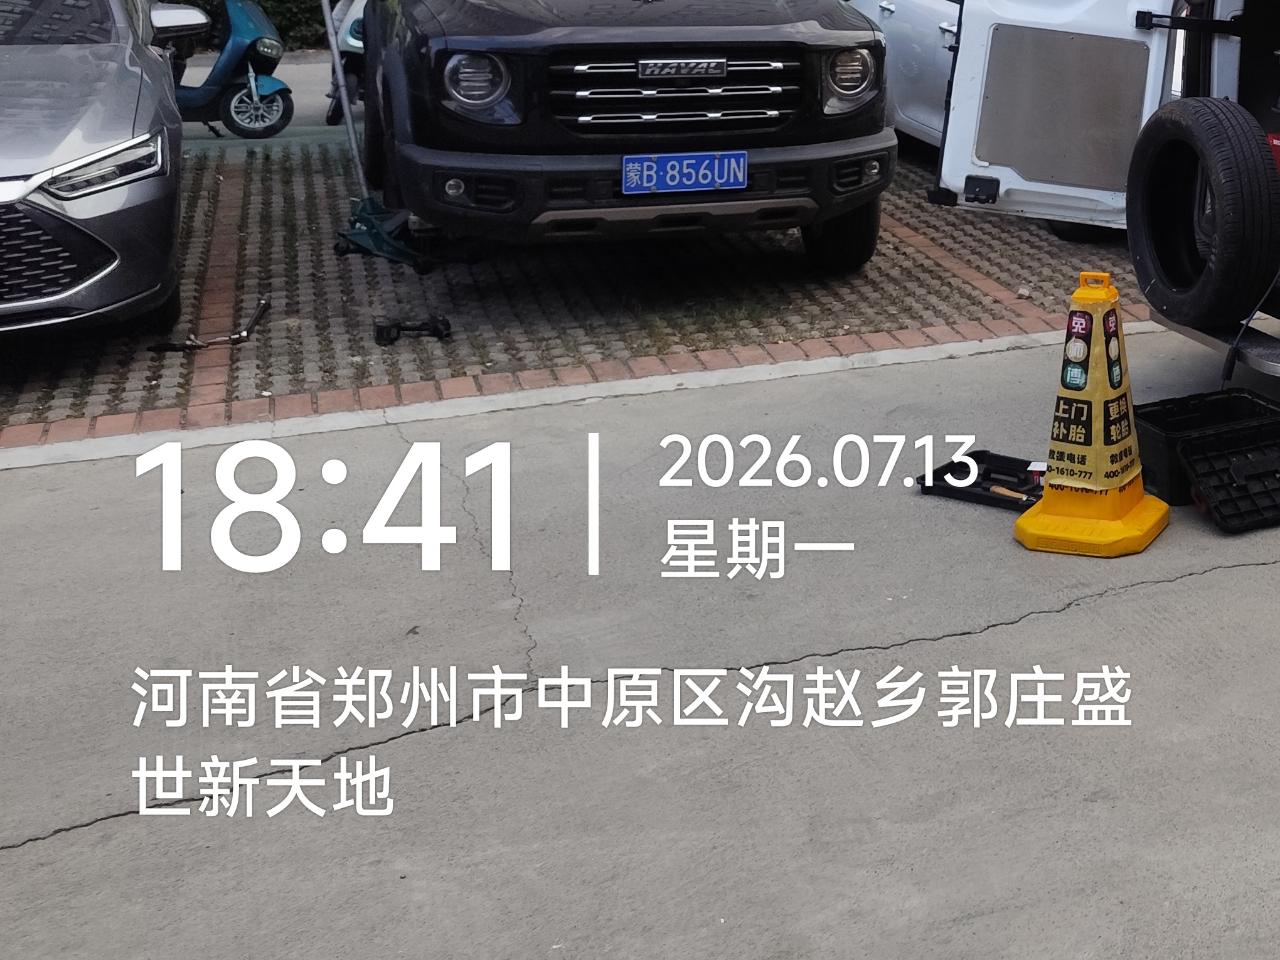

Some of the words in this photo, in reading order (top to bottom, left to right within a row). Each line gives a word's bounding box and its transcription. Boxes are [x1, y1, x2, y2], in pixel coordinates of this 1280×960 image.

[644, 61, 722, 76] HAVAL
[1055, 400, 1088, 421] 上门
[1053, 421, 1086, 443] 补胎
